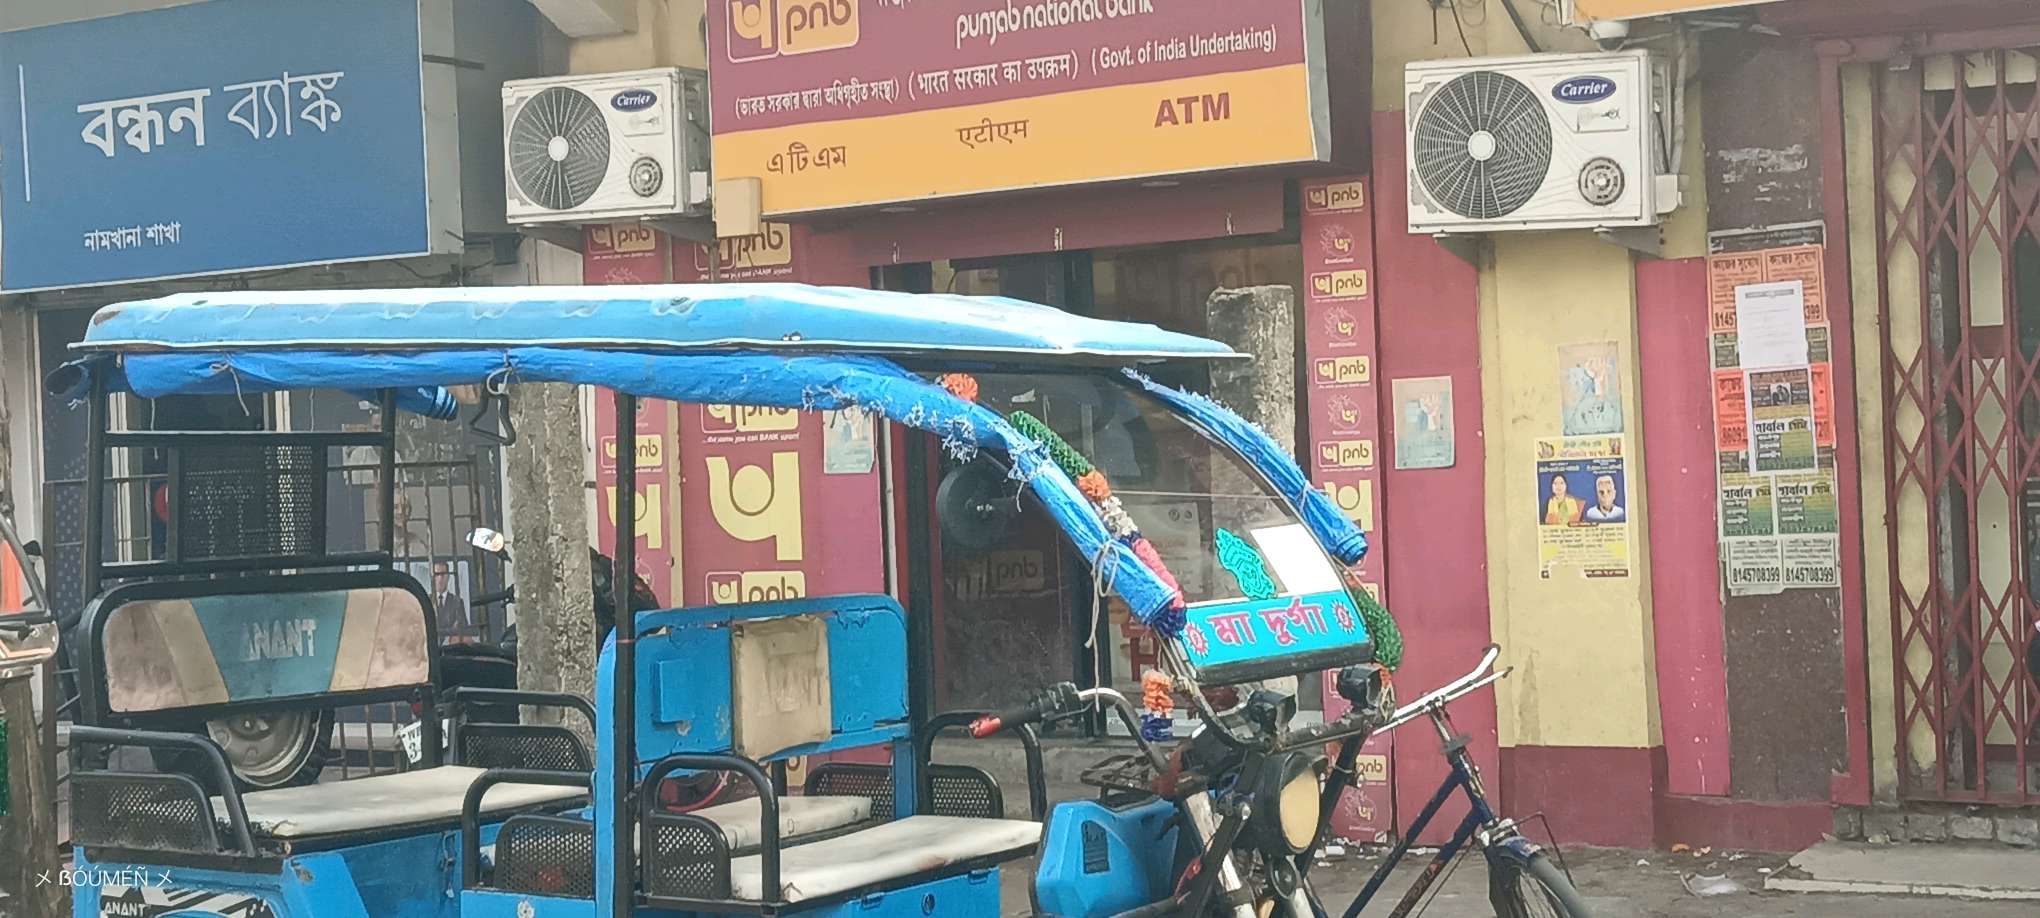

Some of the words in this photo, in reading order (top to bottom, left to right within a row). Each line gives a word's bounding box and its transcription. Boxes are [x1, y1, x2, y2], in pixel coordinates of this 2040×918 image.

[786, 0, 852, 45] pnb
[956, 0, 1020, 49] punjab
[1023, 0, 1103, 30] national
[1137, 40, 1151, 64] of
[1154, 37, 1187, 62] India
[1189, 23, 1277, 58] Undertaking)
[953, 64, 999, 91] सरकार
[1002, 61, 1021, 83] का
[1560, 81, 1608, 97] Carrier
[616, 93, 651, 107] Carrier
[768, 92, 801, 113] সরকার
[801, 88, 822, 110] দ্বারা
[823, 77, 869, 109] অধিগৃহীত
[1154, 92, 1230, 128] ATM
[77, 88, 211, 157] বন্ধন
[223, 71, 344, 139] ব্যাঙ্ক
[955, 117, 1029, 150] एटीएम
[1332, 184, 1359, 206] pnb
[84, 225, 142, 252] নামখানা
[145, 221, 181, 246] শাখা
[1336, 274, 1363, 293] pnb
[1340, 359, 1366, 380] pnb
[636, 438, 658, 458] nb
[1343, 443, 1369, 463] pnb
[996, 556, 1038, 580] pnb
[1206, 612, 1257, 646] মা
[103, 901, 147, 917] ANANT
